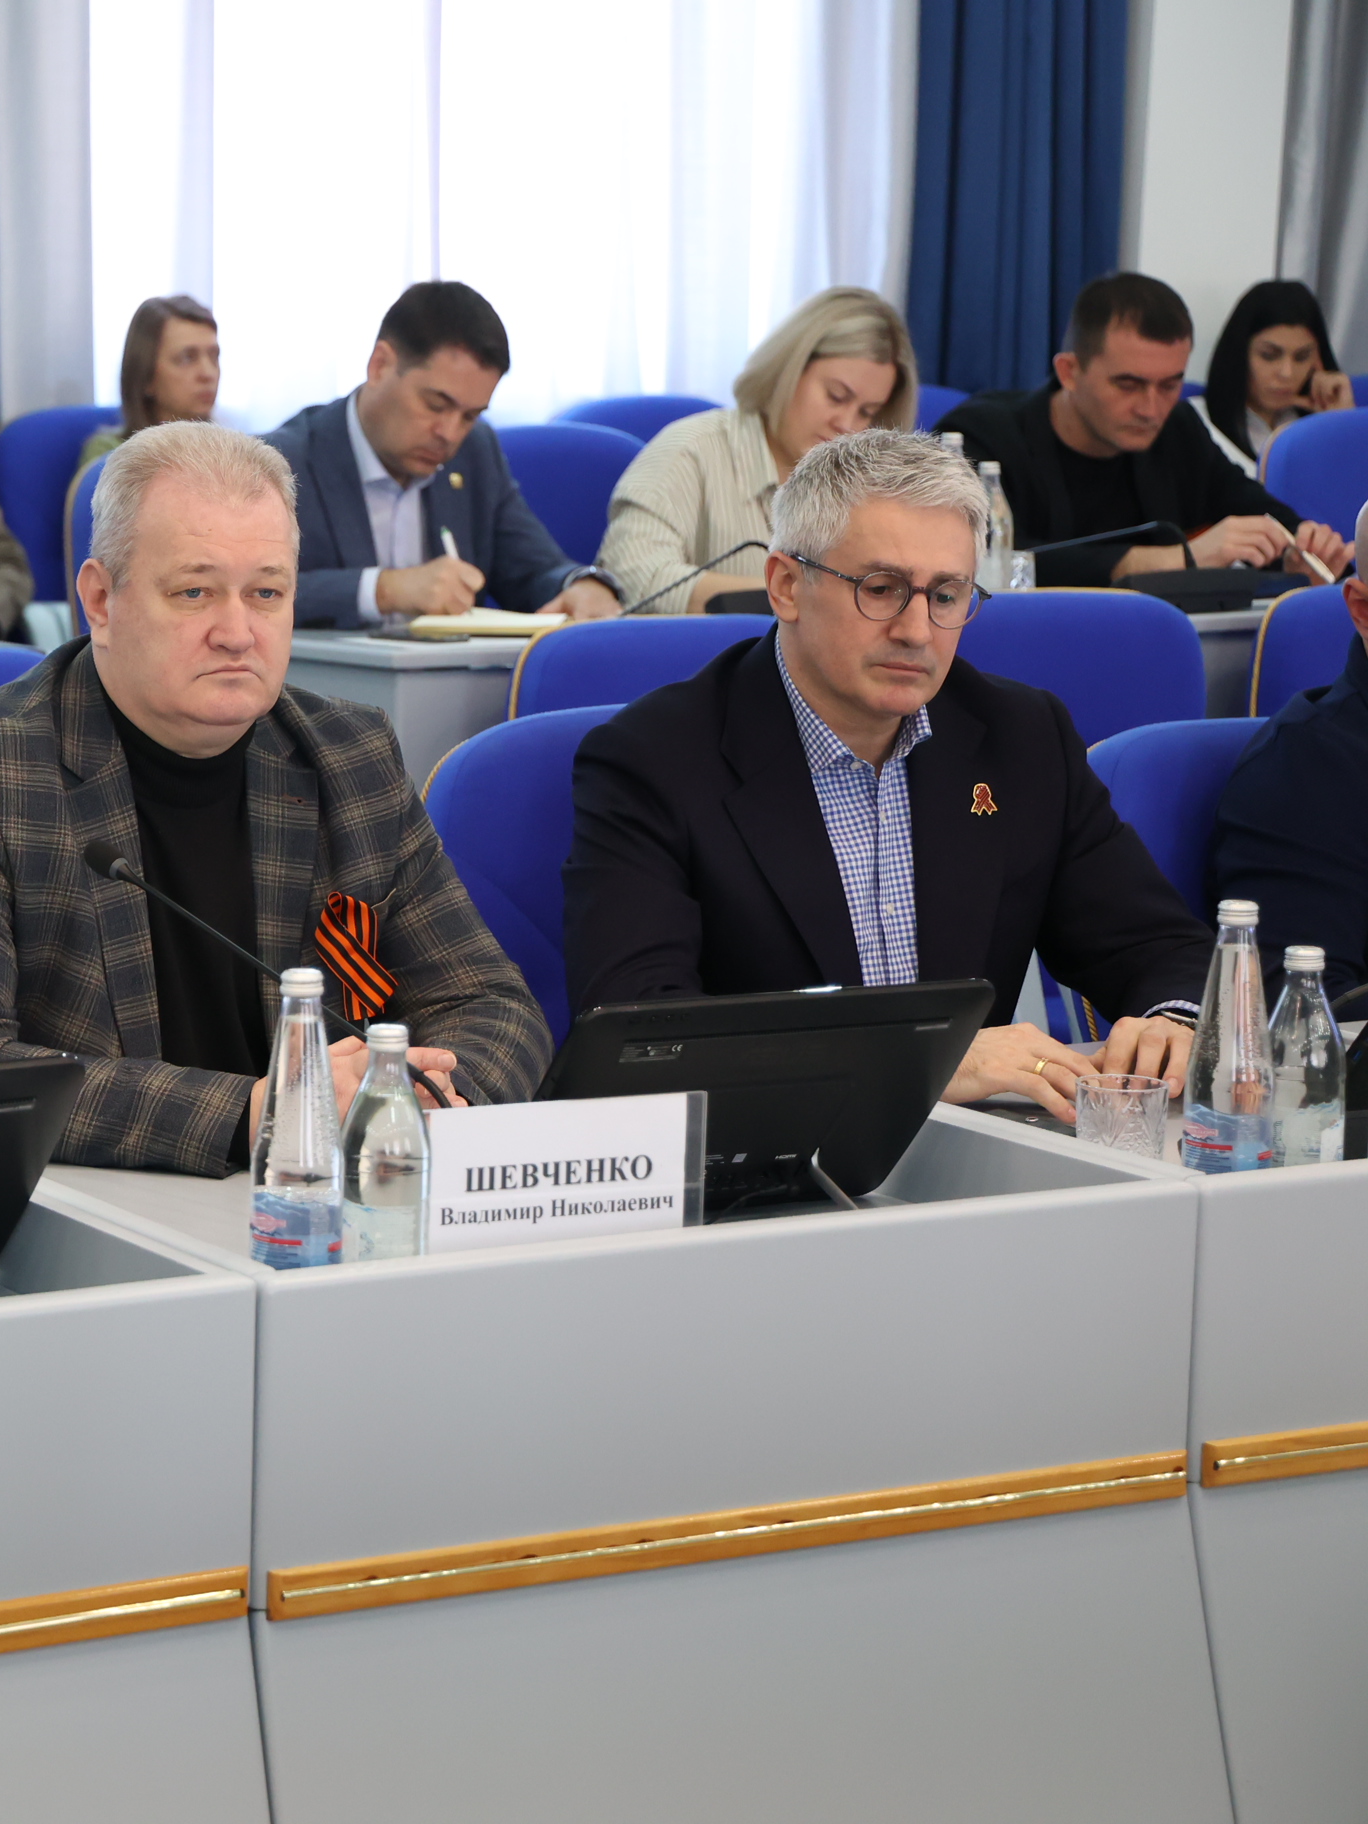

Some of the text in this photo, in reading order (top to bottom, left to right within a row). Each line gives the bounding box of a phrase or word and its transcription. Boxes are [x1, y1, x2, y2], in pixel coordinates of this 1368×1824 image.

[464, 1153, 654, 1193] ШЕВЧЕНКО
[439, 1194, 675, 1226] Владимир Николаевич
